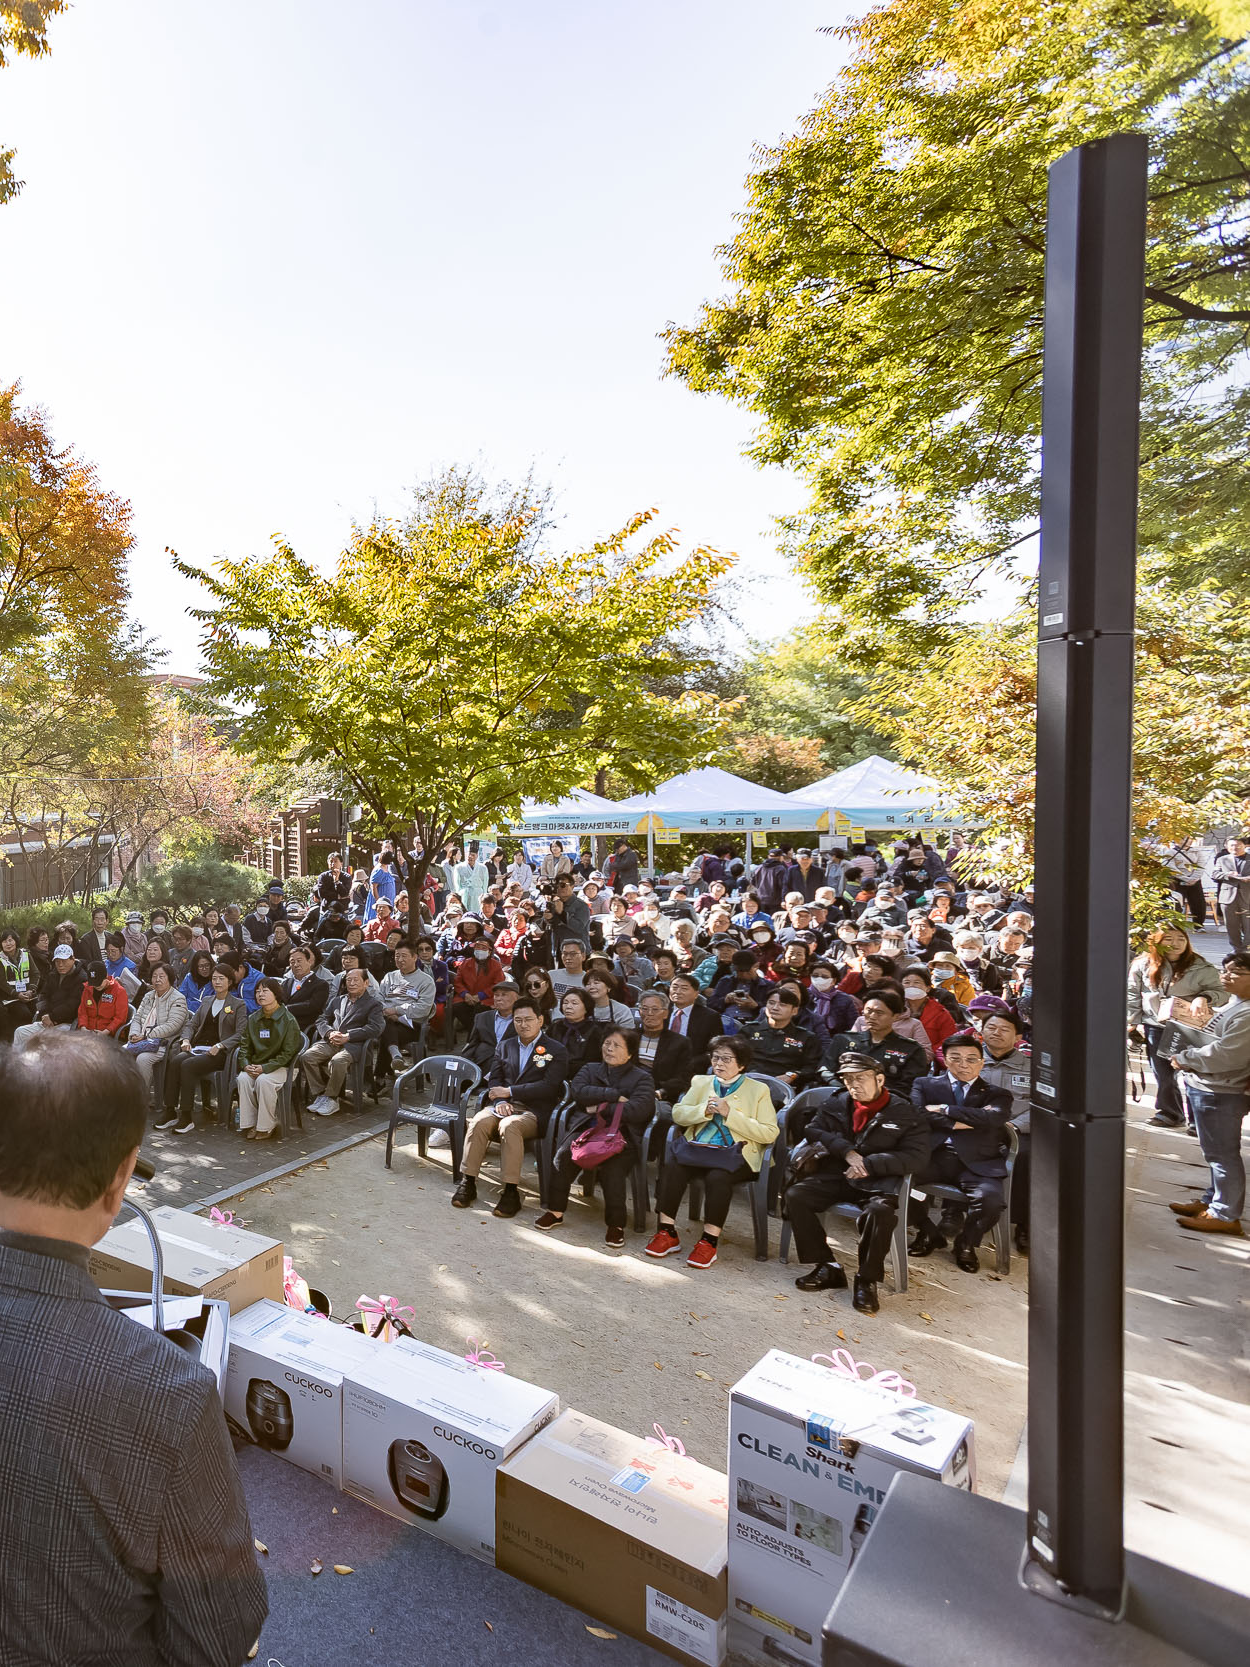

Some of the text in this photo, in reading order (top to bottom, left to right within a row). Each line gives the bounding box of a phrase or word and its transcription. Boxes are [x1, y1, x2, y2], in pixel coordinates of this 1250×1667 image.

[284, 1372, 333, 1398] CUCKOO
[433, 1425, 496, 1460] CUCKOO
[737, 1433, 820, 1479] CLEAN
[824, 1471, 833, 1481] &
[805, 1446, 856, 1475] Shark
[736, 1522, 805, 1557] AUTO-ADJUSTS
[736, 1528, 749, 1538] TO
[750, 1534, 781, 1553] FLOOR
[782, 1548, 812, 1567] TYPES
[655, 1599, 706, 1631] RMW-C20S
